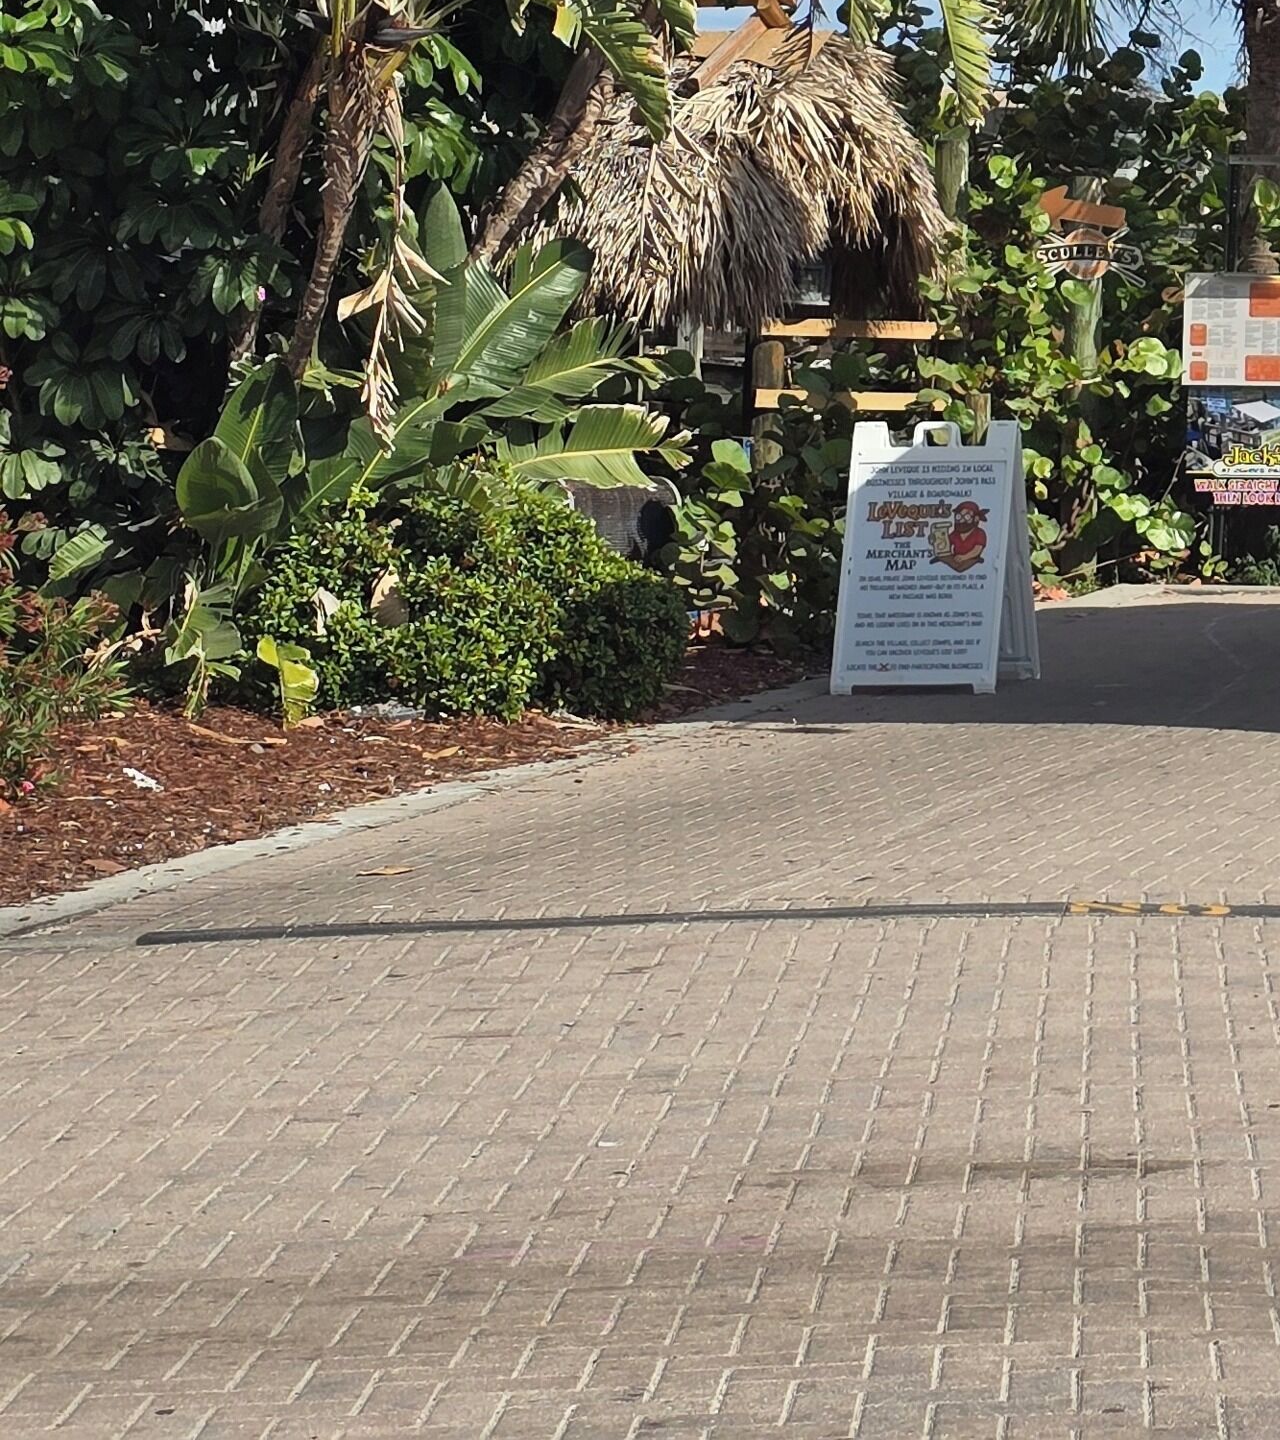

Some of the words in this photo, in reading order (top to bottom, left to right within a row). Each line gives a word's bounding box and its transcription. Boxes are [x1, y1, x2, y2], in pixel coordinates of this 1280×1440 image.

[1036, 246, 1132, 264] SCULLEY'S
[1194, 479, 1226, 492] WALK
[1228, 479, 1279, 492] STRAIGHT
[888, 490, 917, 498] VILLAGE
[1213, 492, 1241, 504] THEN
[1242, 492, 1275, 504] LOOK
[881, 520, 929, 540] LIST
[894, 541, 910, 549] THE
[885, 560, 917, 571] MAP
